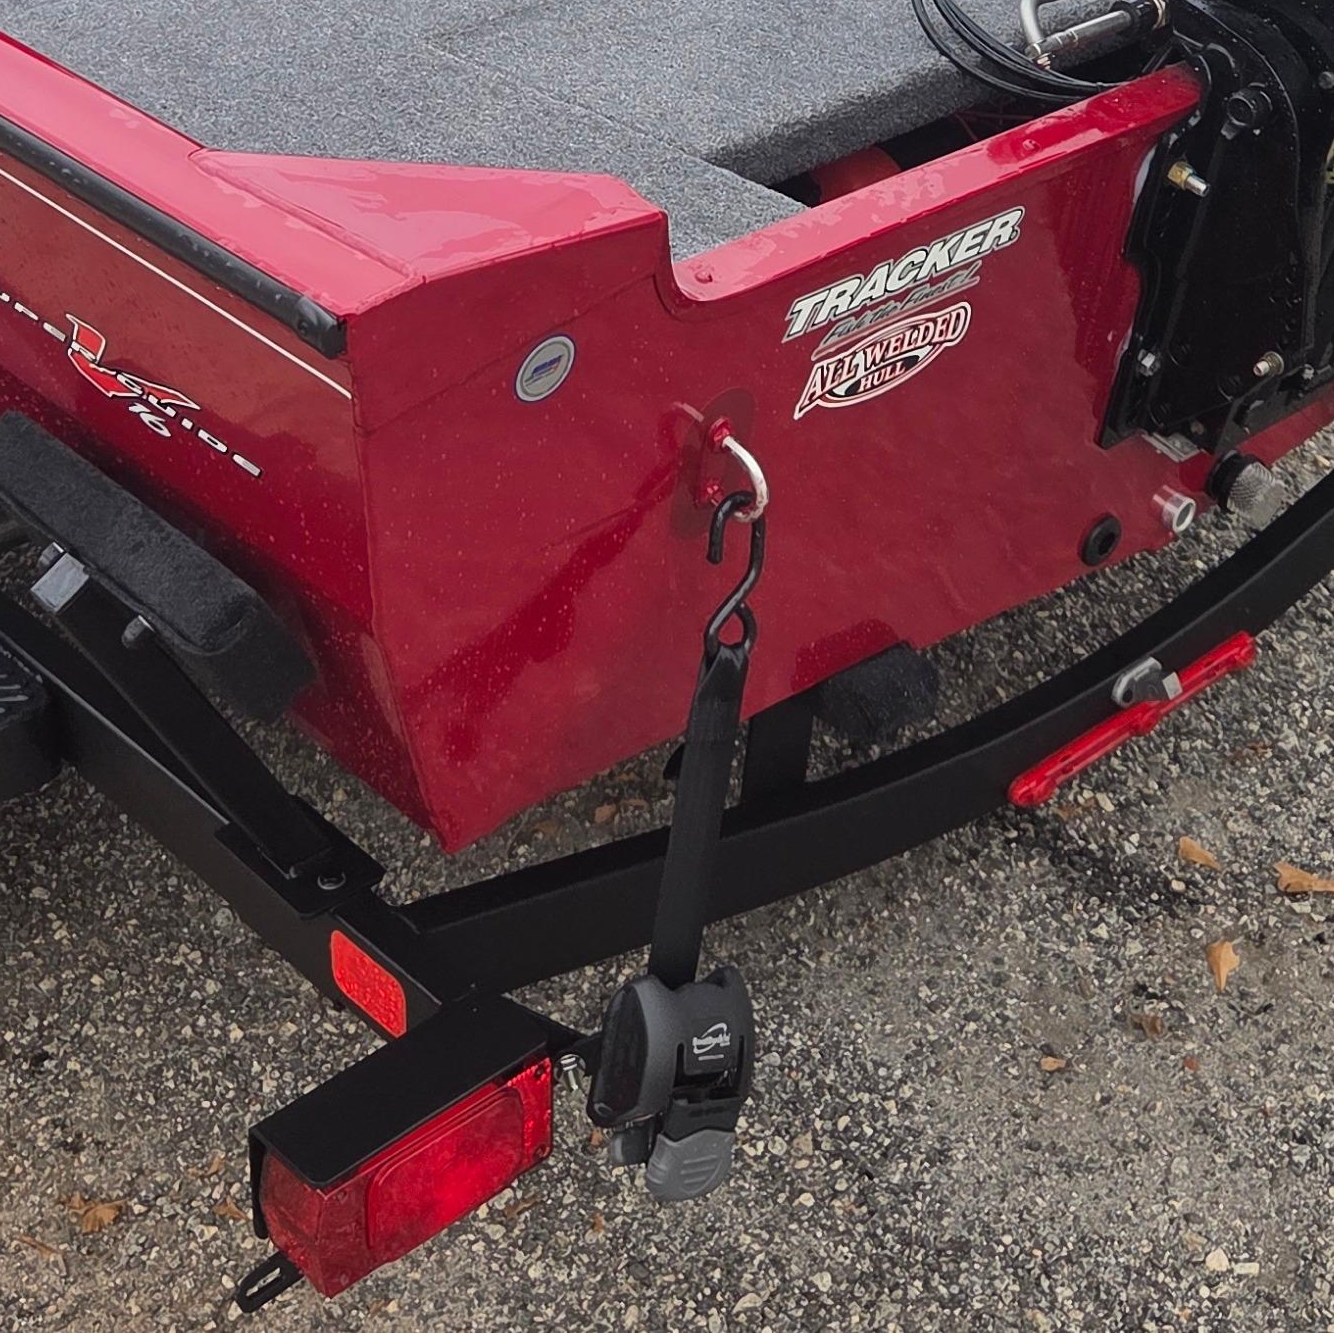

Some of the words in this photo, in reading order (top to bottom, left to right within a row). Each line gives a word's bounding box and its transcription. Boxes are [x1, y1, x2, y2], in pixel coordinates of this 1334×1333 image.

[785, 207, 1024, 341] TRACKER
[800, 353, 858, 409] ALL
[861, 308, 967, 371] WELDED
[857, 361, 906, 392] HULL
[116, 372, 262, 477] GUIDE
